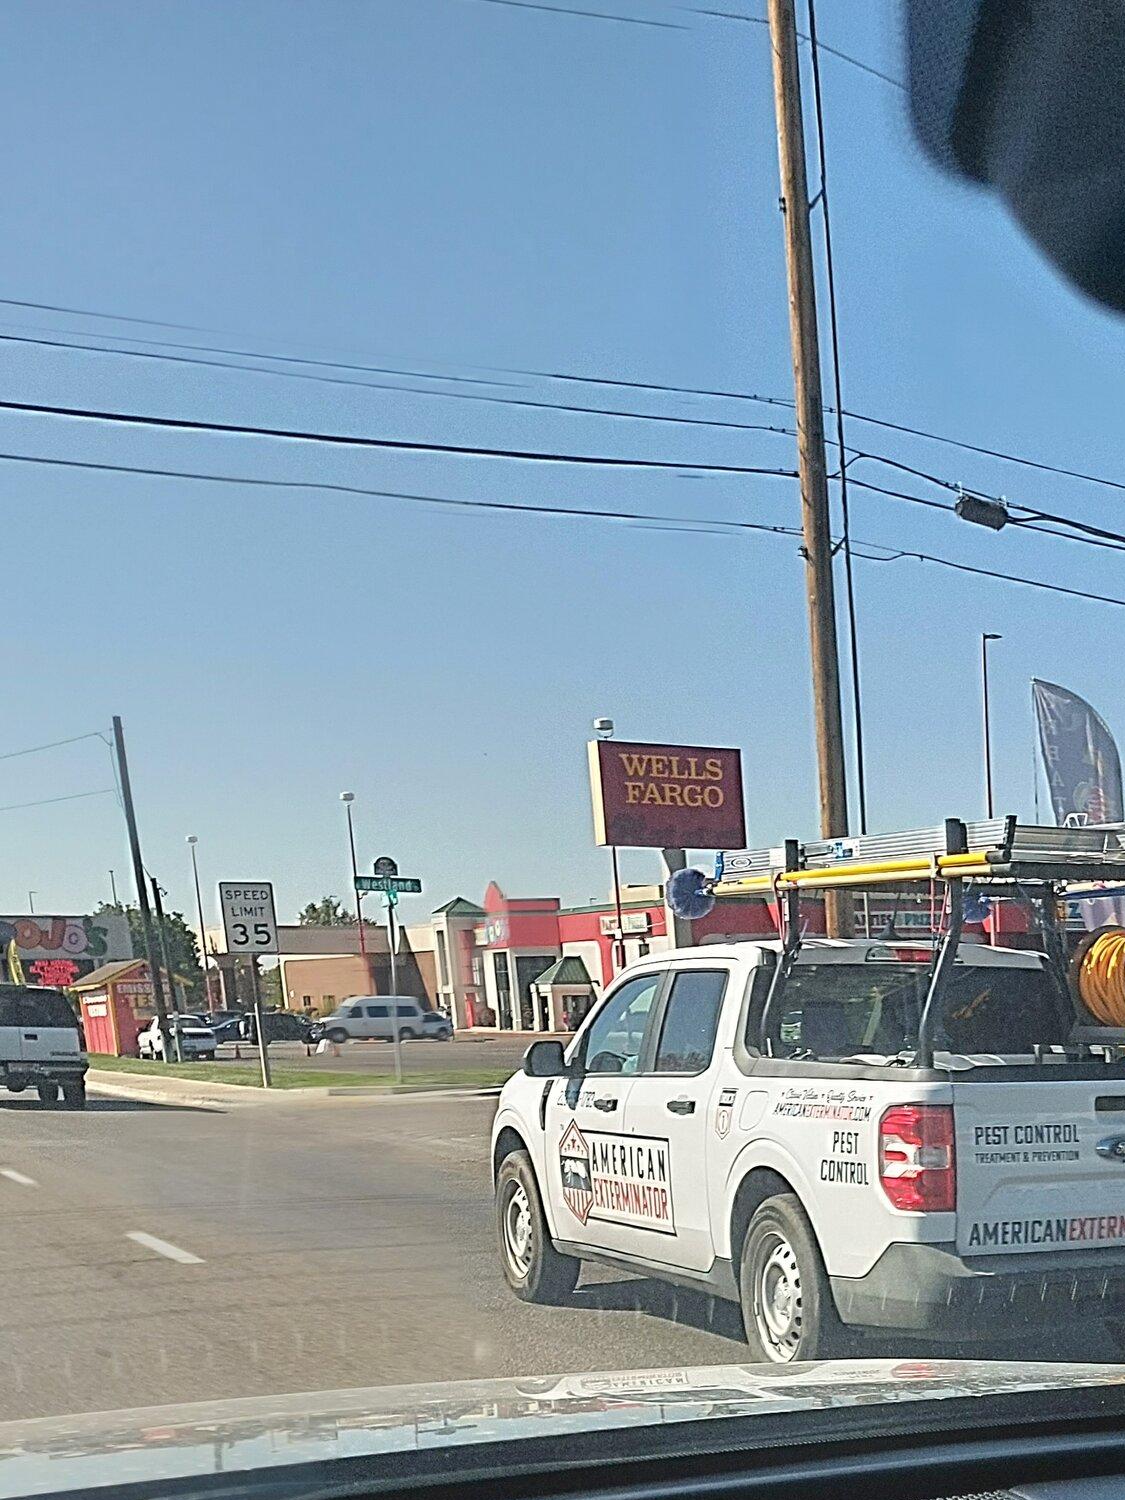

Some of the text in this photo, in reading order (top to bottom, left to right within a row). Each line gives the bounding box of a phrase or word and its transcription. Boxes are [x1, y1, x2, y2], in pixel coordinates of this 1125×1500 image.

[618, 753, 723, 781] WELLS
[625, 781, 724, 808] FARGO
[225, 890, 269, 901] SPEED
[361, 879, 413, 891] Westland
[231, 906, 265, 917] LIMIT
[232, 923, 272, 946] 35
[833, 1131, 859, 1154] PEST
[974, 1123, 1080, 1146] PEST CONTROL
[592, 1141, 666, 1182] AMERICAN
[975, 1150, 1080, 1164] TREATMENT & PREVENTION
[820, 1159, 869, 1185] CONTROL
[593, 1178, 669, 1220] EXTERMINATOR
